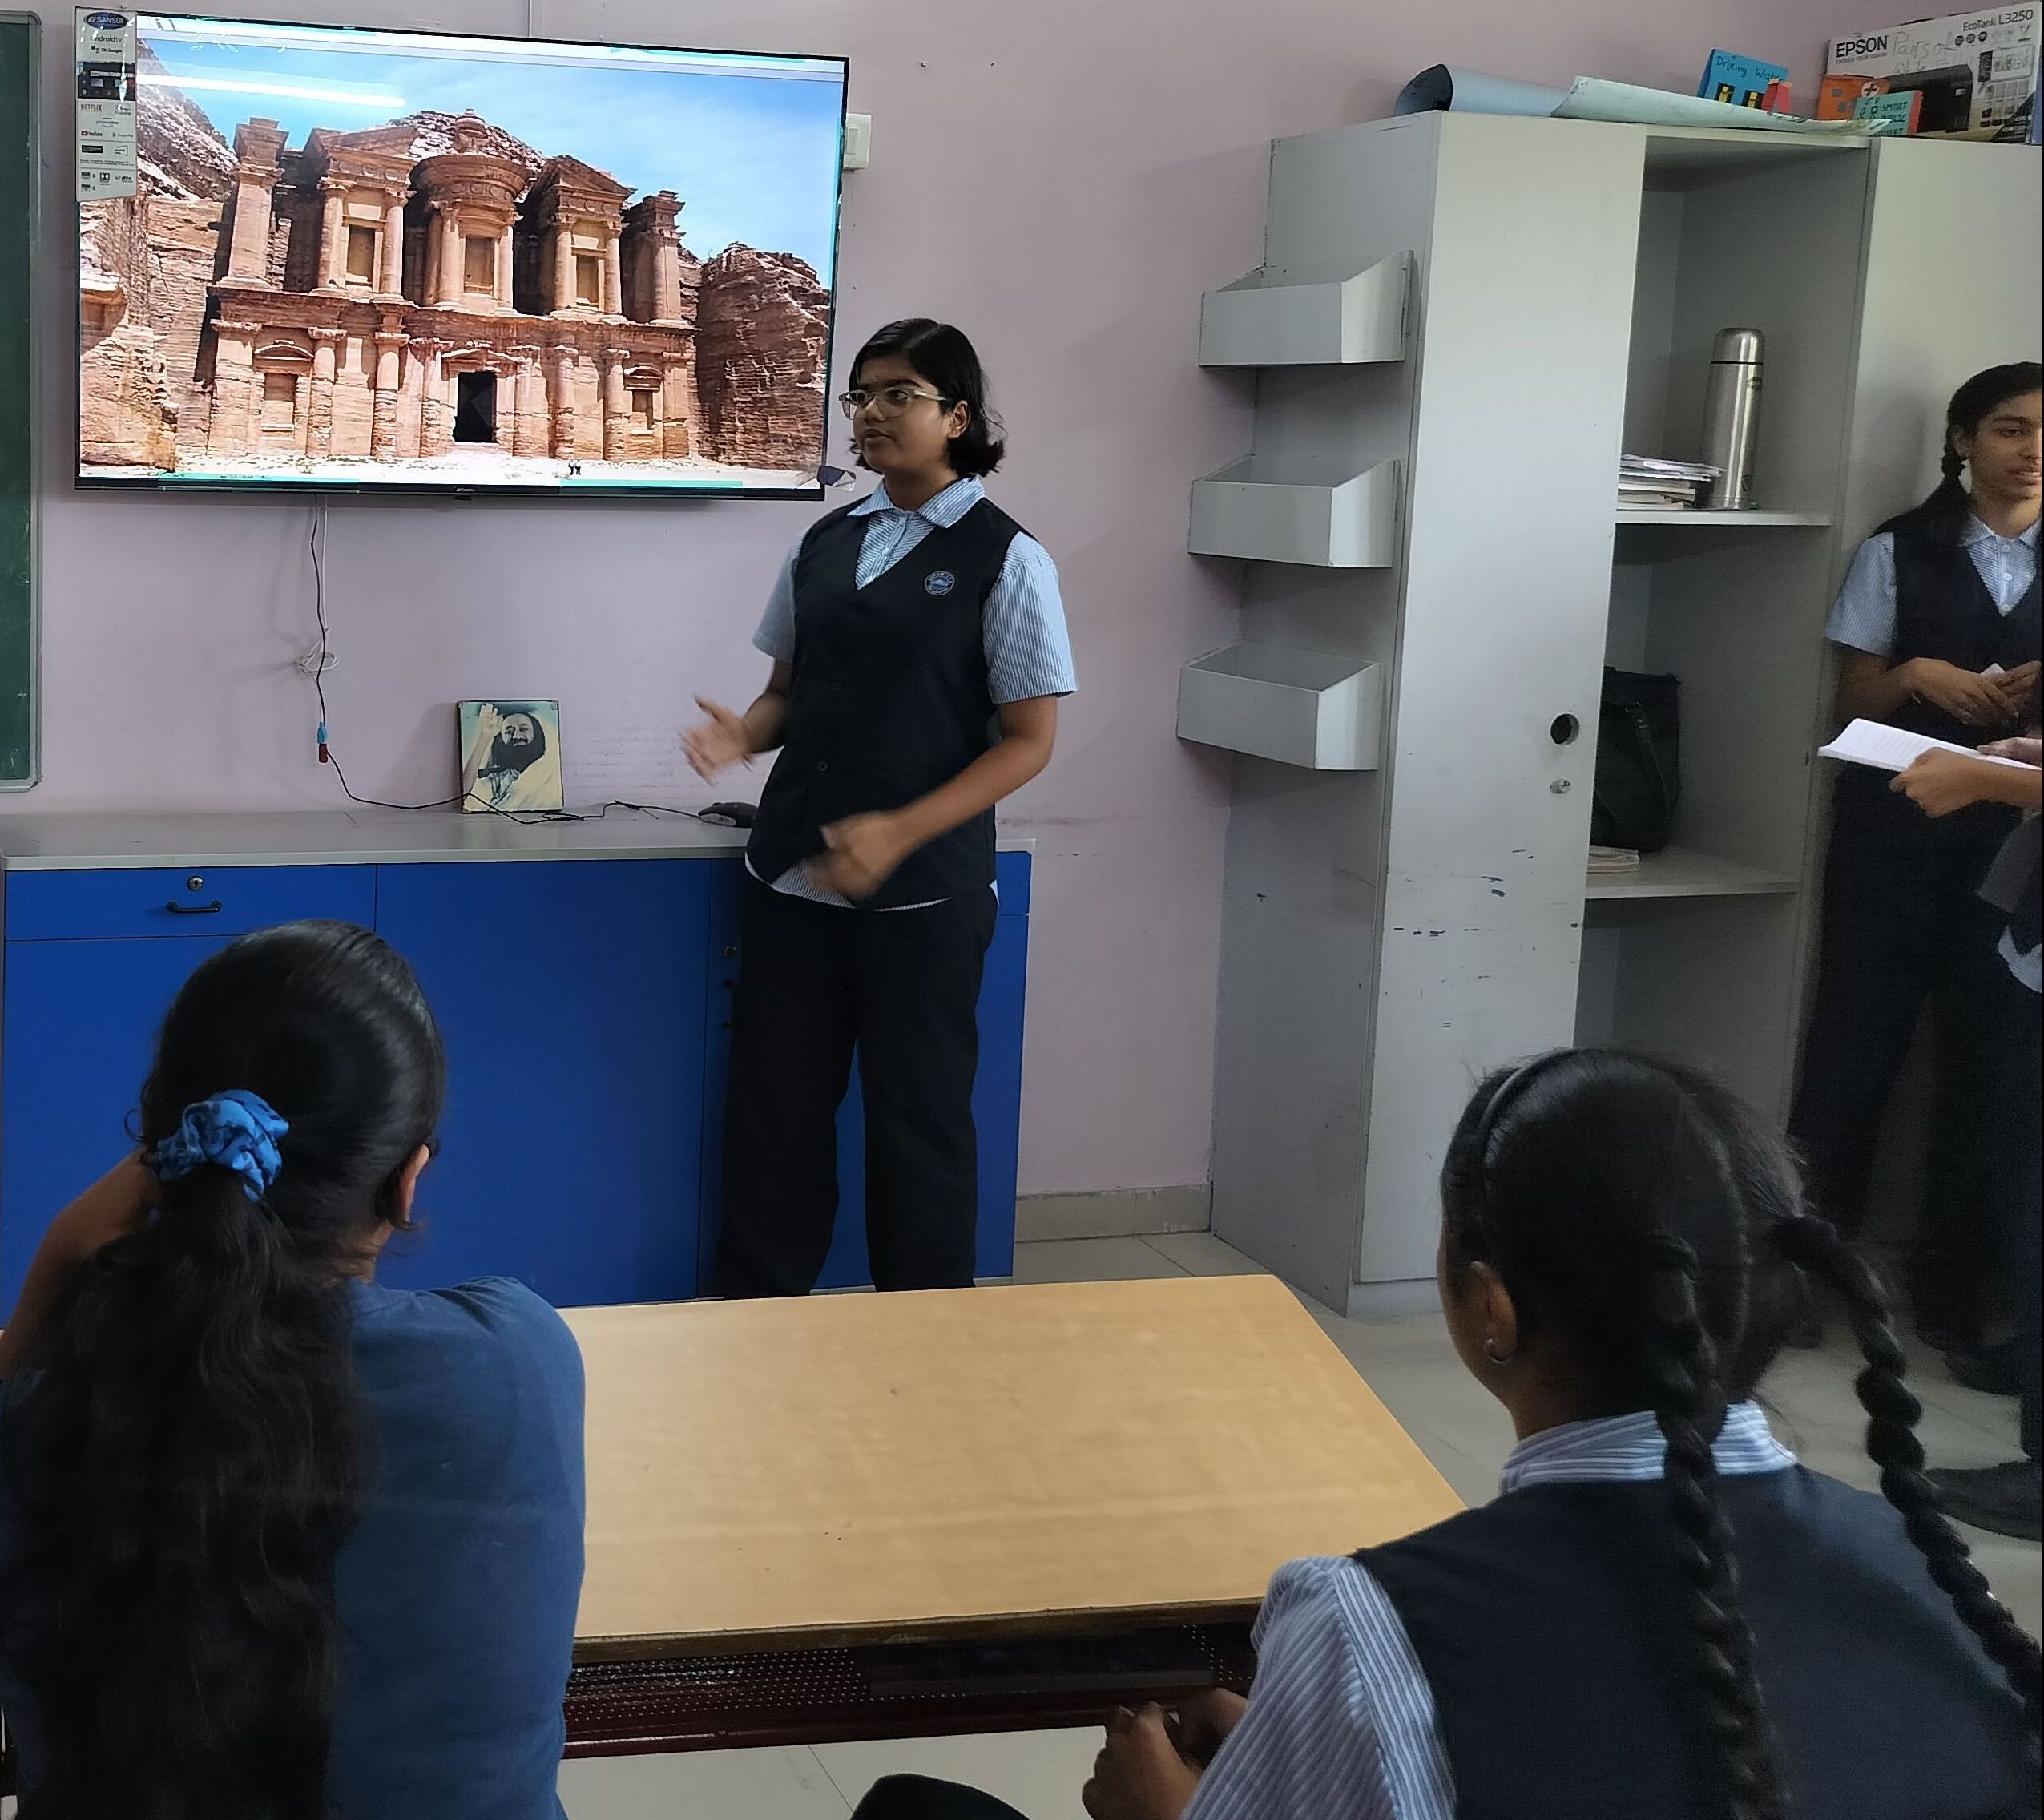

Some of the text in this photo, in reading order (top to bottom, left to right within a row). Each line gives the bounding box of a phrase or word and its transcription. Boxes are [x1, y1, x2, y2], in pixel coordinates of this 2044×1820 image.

[1962, 9, 2034, 31] EcoTank L3250
[1836, 35, 1888, 58] EPSON
